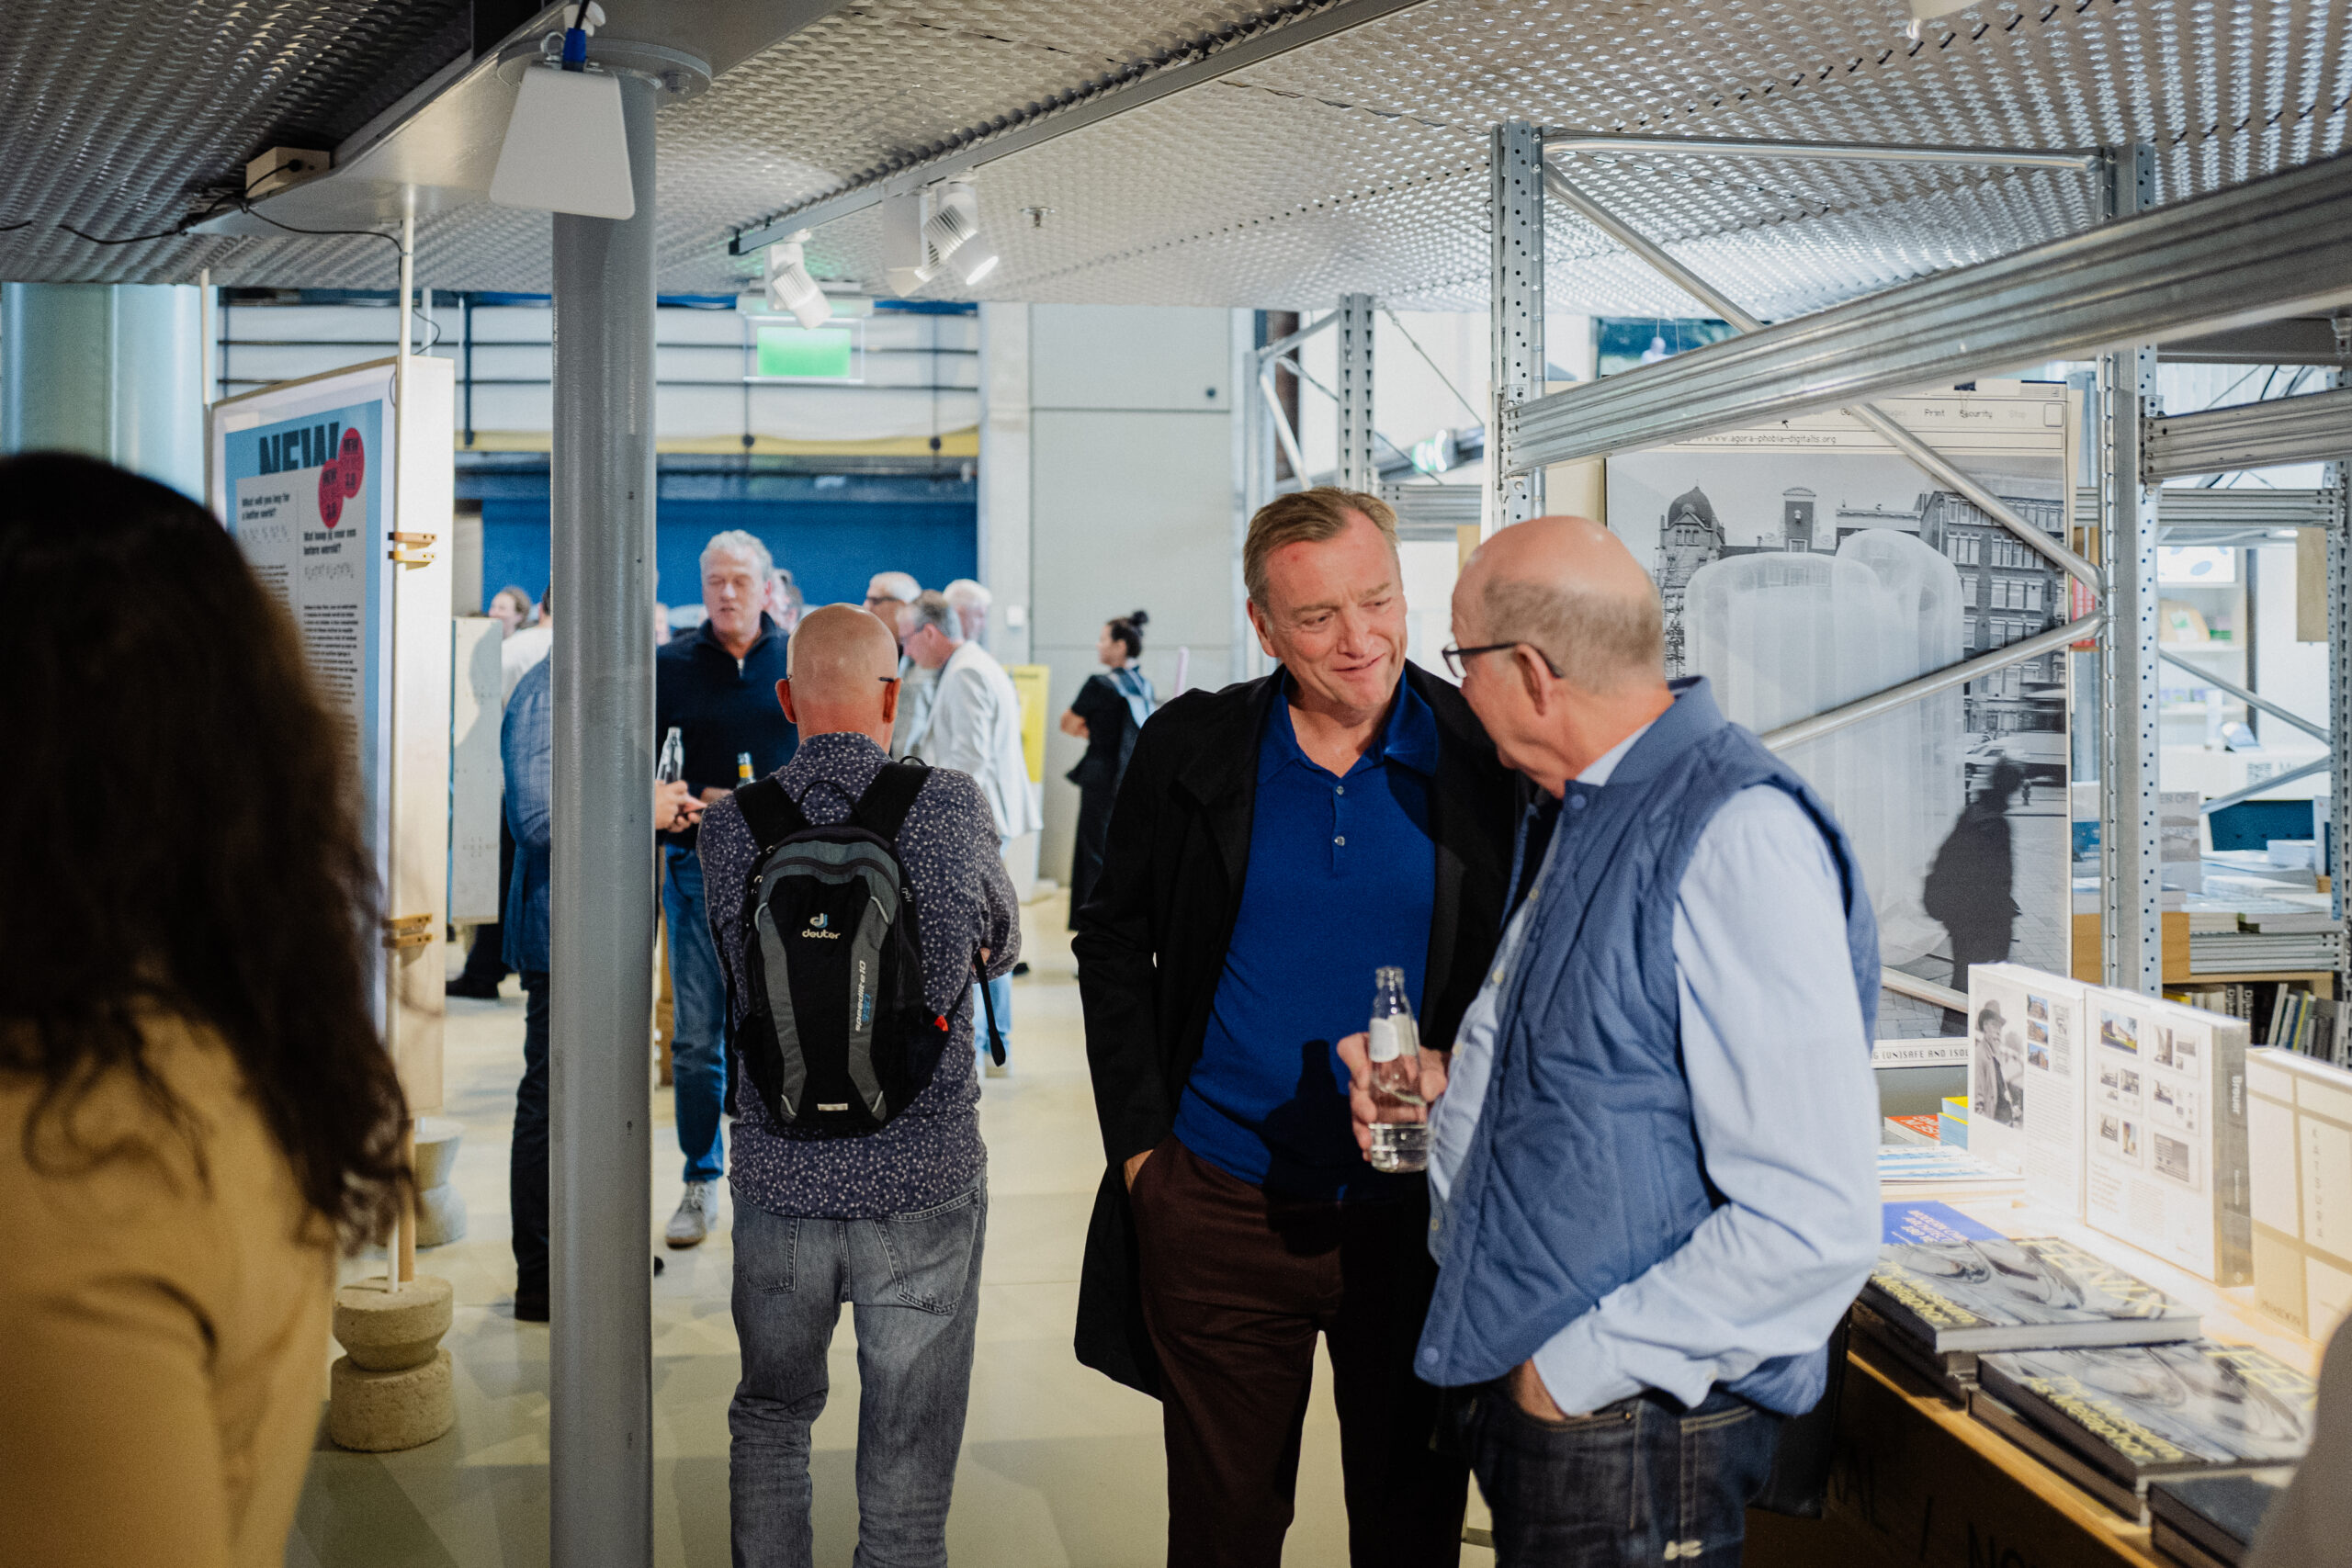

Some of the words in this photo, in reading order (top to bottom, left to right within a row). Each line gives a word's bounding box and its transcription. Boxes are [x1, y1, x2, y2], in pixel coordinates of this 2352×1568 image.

[259, 422, 339, 475] NEW
[802, 928, 841, 940] deuter
[1928, 1049, 1946, 1058] AND
[1950, 1048, 1969, 1057] ISOL
